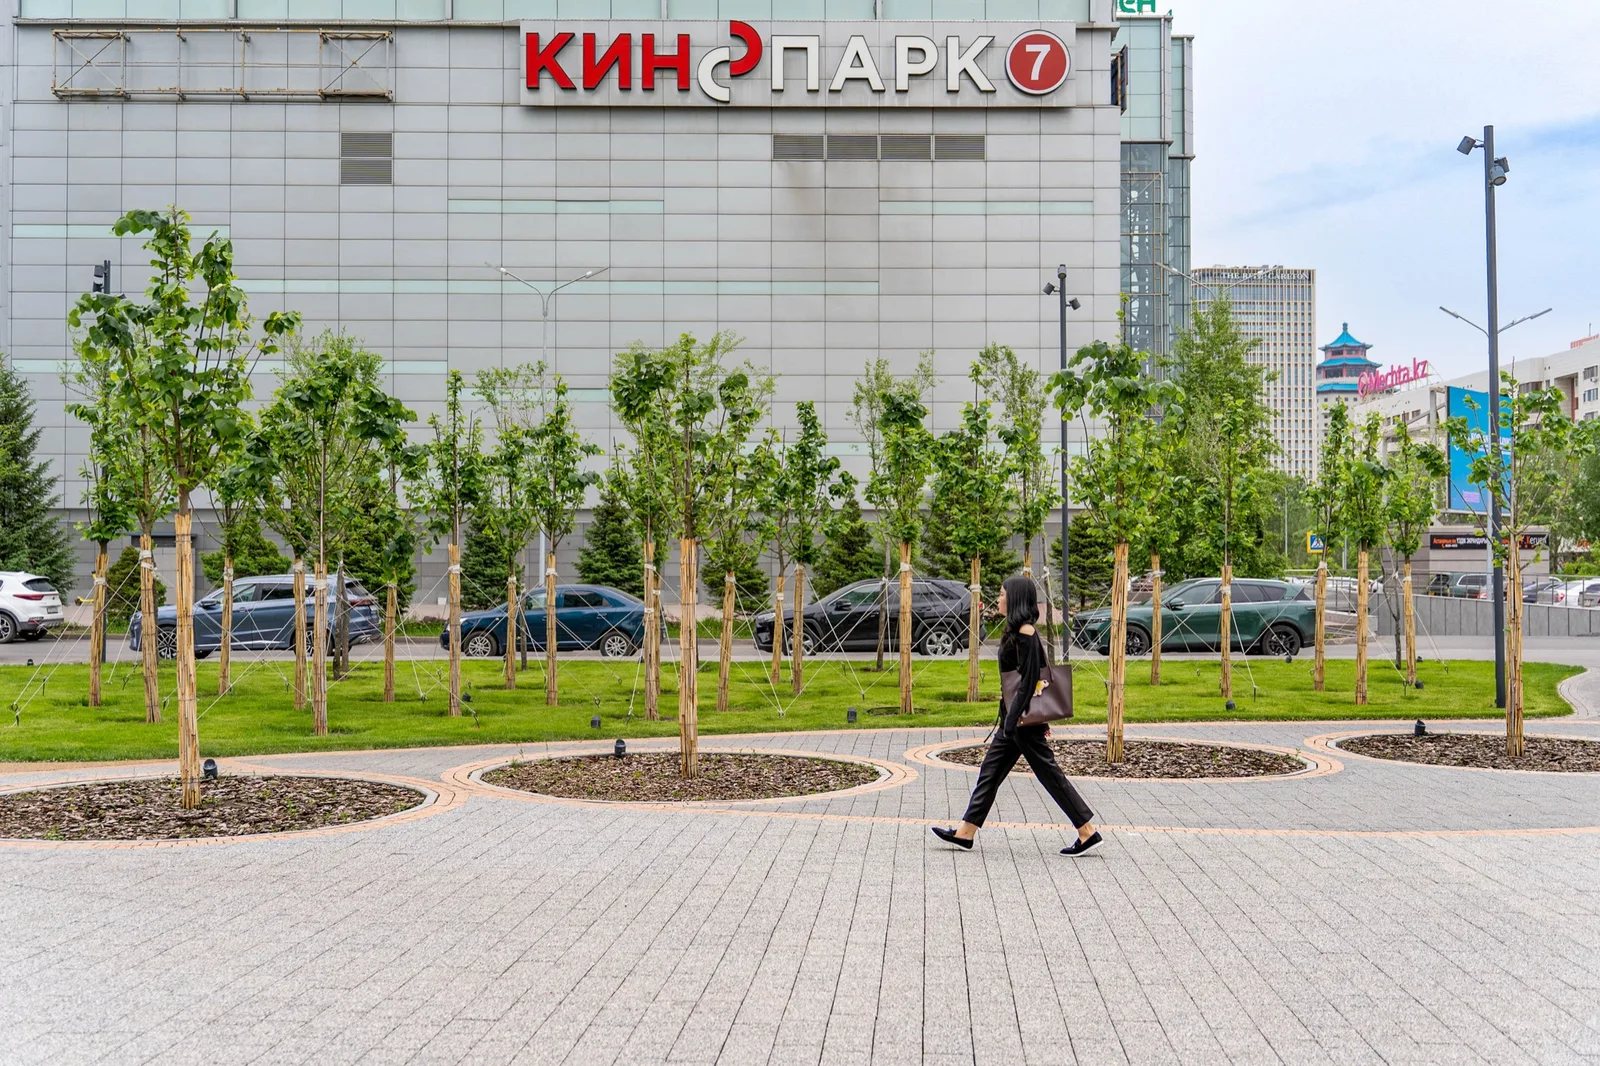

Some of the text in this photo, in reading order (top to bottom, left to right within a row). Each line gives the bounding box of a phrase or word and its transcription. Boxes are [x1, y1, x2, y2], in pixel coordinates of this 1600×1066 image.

[526, 20, 1051, 103] КИНОПАРК 7
[1369, 357, 1428, 394] Mechta.kz
